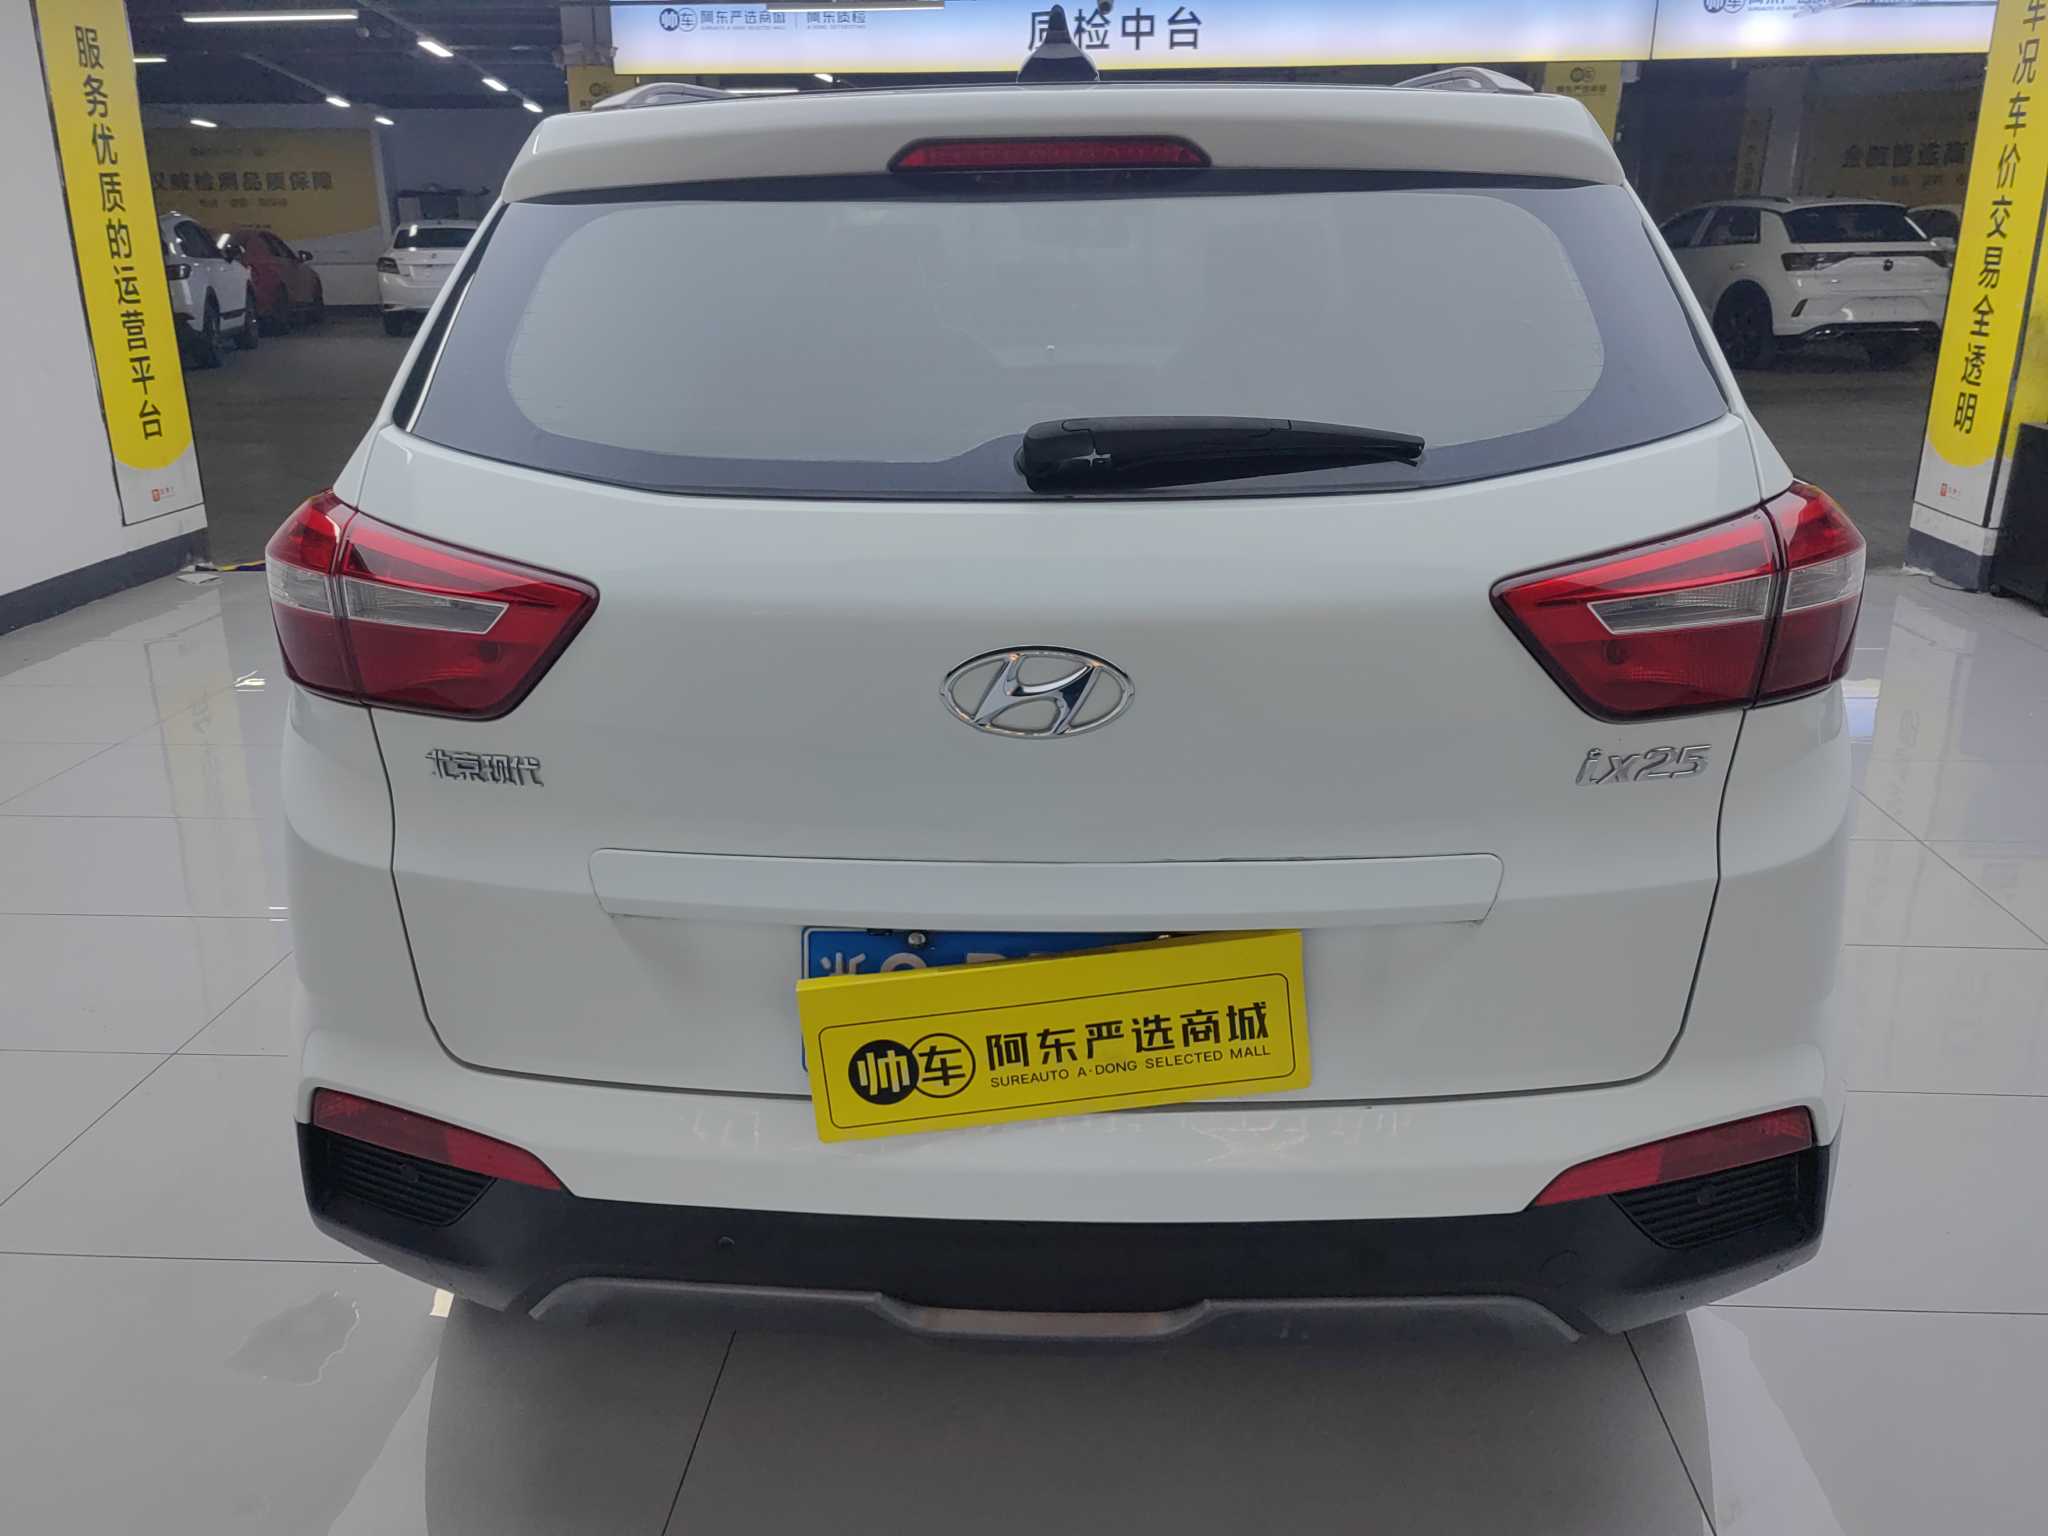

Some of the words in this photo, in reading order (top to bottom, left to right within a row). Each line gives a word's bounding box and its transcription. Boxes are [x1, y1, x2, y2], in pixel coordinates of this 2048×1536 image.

[74, 25, 163, 441] 服务优质的运营平台
[1953, 0, 2047, 435] 车况车价交易全透明
[424, 749, 545, 787] 北京现代
[985, 1002, 1270, 1071] 阿东严选商城
[990, 1068, 1070, 1088] SUREAUTO
[1145, 1049, 1224, 1069] SELECTED
[1230, 1044, 1271, 1060] MALL
